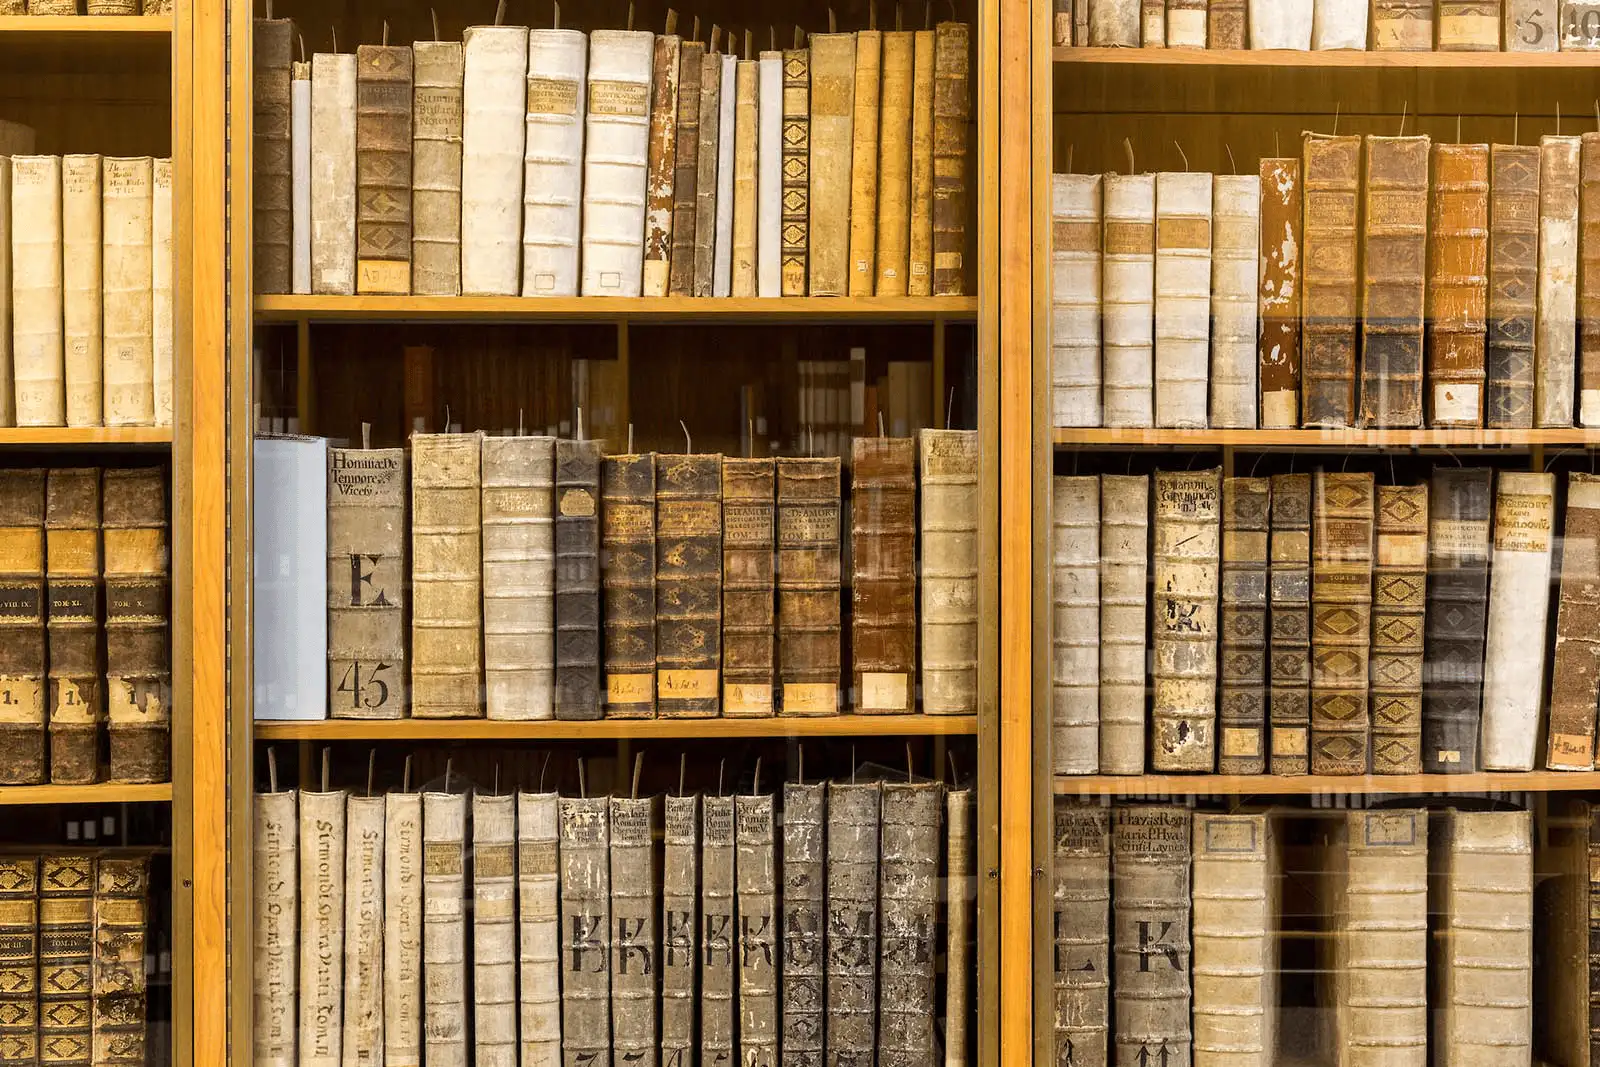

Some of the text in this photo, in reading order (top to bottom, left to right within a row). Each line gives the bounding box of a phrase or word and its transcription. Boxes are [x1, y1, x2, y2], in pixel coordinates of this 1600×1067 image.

[348, 553, 394, 606] E
[336, 660, 393, 708] 45
[617, 917, 652, 975] K
[1135, 920, 1184, 972] K
